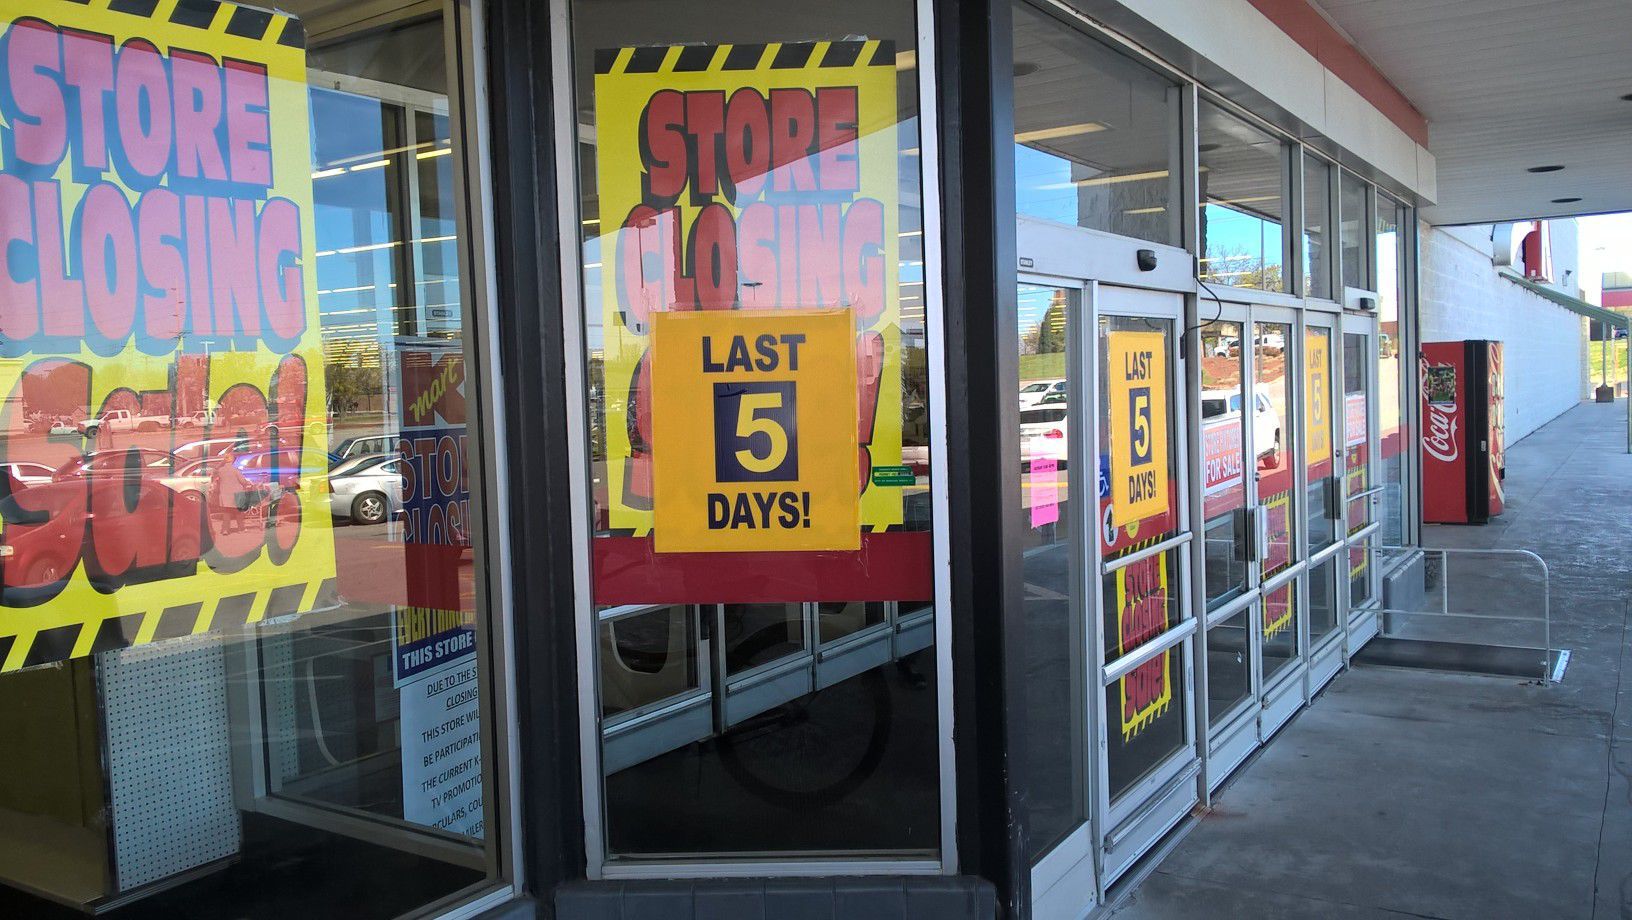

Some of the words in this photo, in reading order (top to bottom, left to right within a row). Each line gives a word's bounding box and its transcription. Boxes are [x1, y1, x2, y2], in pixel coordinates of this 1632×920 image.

[2, 16, 273, 197] STORE
[641, 86, 860, 202] STORE
[0, 173, 306, 352] CLOSING
[616, 198, 887, 325] CLOSING
[702, 334, 806, 373] LAST
[1125, 351, 1153, 381] LAST
[408, 357, 460, 422] mart
[1314, 378, 1322, 422] 5
[734, 392, 788, 473] 5
[1134, 395, 1150, 458] 5
[0, 353, 307, 609] Sale!
[1129, 469, 1157, 504] DAYS!
[1206, 457, 1221, 483] FOR
[1222, 451, 1241, 478] SALE
[394, 500, 472, 546] CLOSI
[707, 491, 811, 530] DAYS!
[1124, 553, 1162, 602] STORE
[1121, 587, 1167, 651] CLOSING
[402, 645, 433, 670] THIS
[435, 631, 473, 658] STORE
[427, 680, 443, 695] DUE
[445, 675, 455, 687] TO
[457, 668, 471, 682] THE
[446, 687, 478, 708] CLOSING
[422, 727, 440, 743] THIS
[441, 715, 465, 734] STORE
[423, 753, 434, 767] BE
[435, 731, 480, 762] PARTICIPATI
[421, 776, 437, 792] THE
[439, 758, 474, 784] CURRENT
[432, 795, 441, 809] TV
